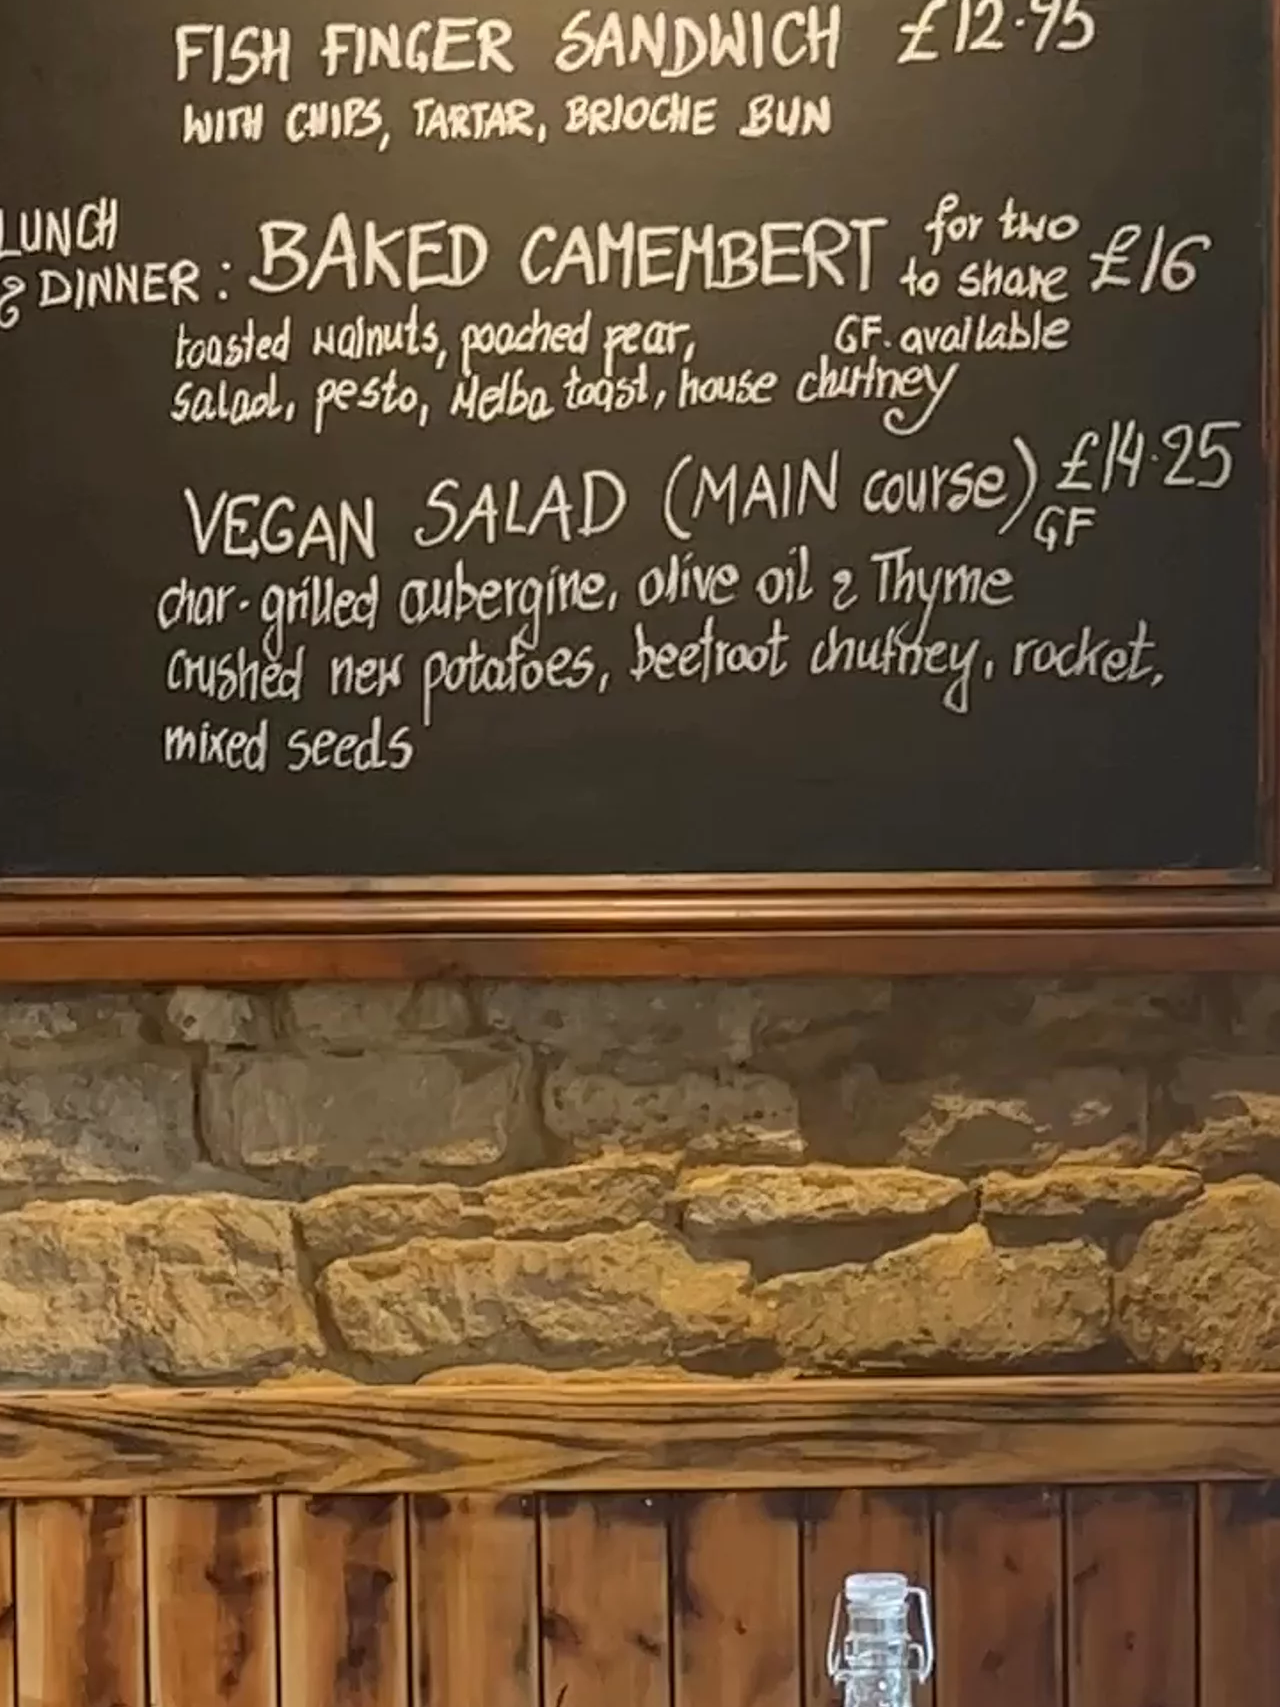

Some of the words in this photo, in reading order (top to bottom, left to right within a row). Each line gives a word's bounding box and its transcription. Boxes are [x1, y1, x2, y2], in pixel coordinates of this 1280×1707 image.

[173, 24, 292, 85] FISH
[320, 16, 515, 78] FINGER
[553, 3, 841, 78] SANDWICH
[182, 102, 264, 145] WITH
[285, 96, 391, 153] CHIPS,
[412, 96, 547, 144] TARTAR,
[564, 92, 717, 137] BRIOCHE
[738, 94, 831, 139] BUN
[248, 212, 488, 294] BAKED
[519, 216, 888, 293] CAMEMBERT
[1088, 223, 1212, 295] £16
[924, 192, 983, 256] for
[998, 196, 1080, 243] two
[898, 256, 940, 298] to
[956, 257, 1069, 302] share
[174, 315, 292, 370] toasted
[459, 307, 591, 376] poached
[602, 315, 698, 376] pear,
[899, 313, 1072, 354] available
[315, 368, 430, 436] pesto,
[562, 363, 668, 411] toast,
[678, 368, 778, 410] house
[795, 355, 960, 437] chutney
[184, 487, 377, 565] VEGAN
[414, 468, 628, 549] SALAD
[662, 447, 840, 540] (MAIN
[862, 435, 1038, 537] course)
[1034, 505, 1096, 552] GF
[399, 559, 617, 650] aubergine,
[638, 550, 740, 607] olive
[756, 544, 814, 606] oil
[870, 545, 1015, 641] Thyme
[166, 645, 307, 702] crushed
[330, 652, 403, 697] new
[422, 636, 610, 727] potatoes,
[630, 615, 790, 682] beetroot
[809, 620, 994, 714] chutney,
[1013, 618, 1165, 688] rocket,
[163, 719, 268, 773] mixed
[287, 716, 413, 773] seeds
